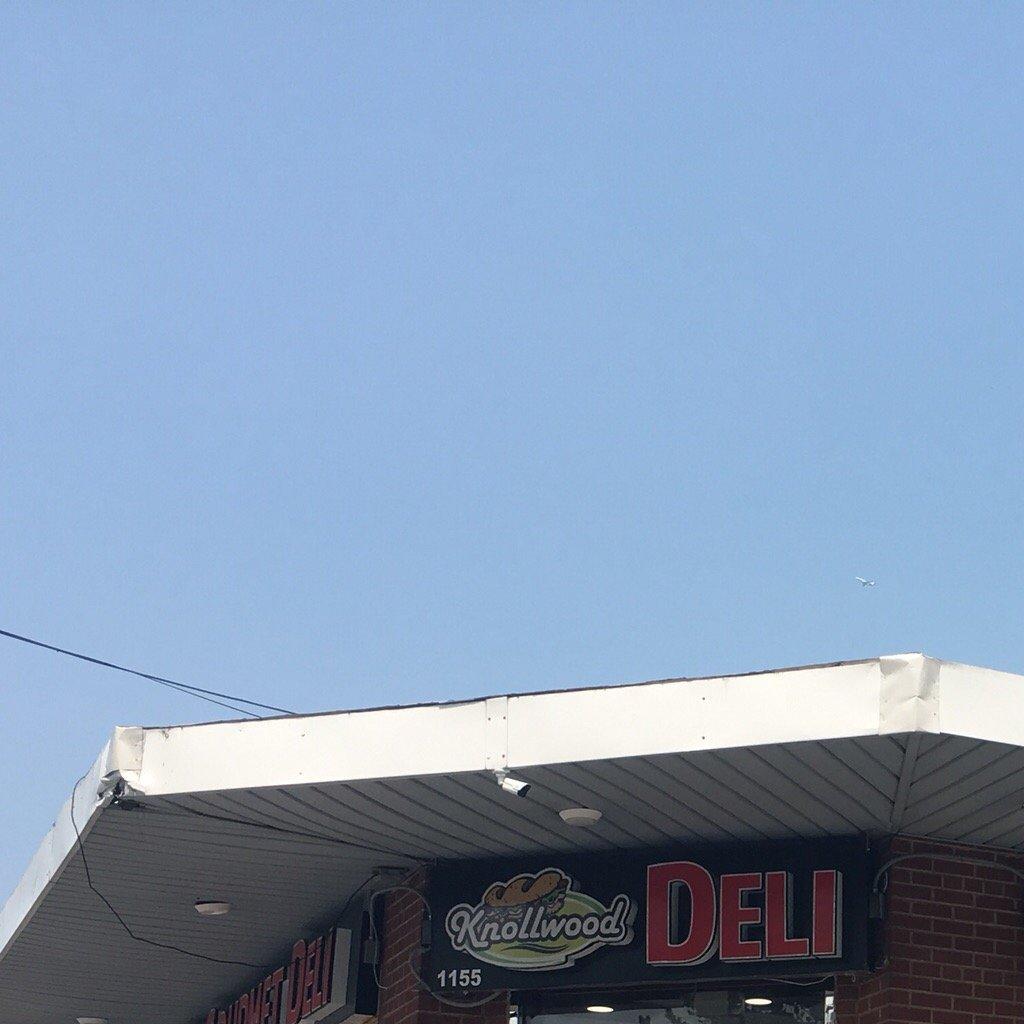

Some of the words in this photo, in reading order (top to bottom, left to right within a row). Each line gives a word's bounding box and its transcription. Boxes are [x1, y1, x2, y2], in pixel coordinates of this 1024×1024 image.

[450, 898, 623, 947] Knollwood
[646, 861, 840, 965] DELI
[437, 969, 482, 988] 1155
